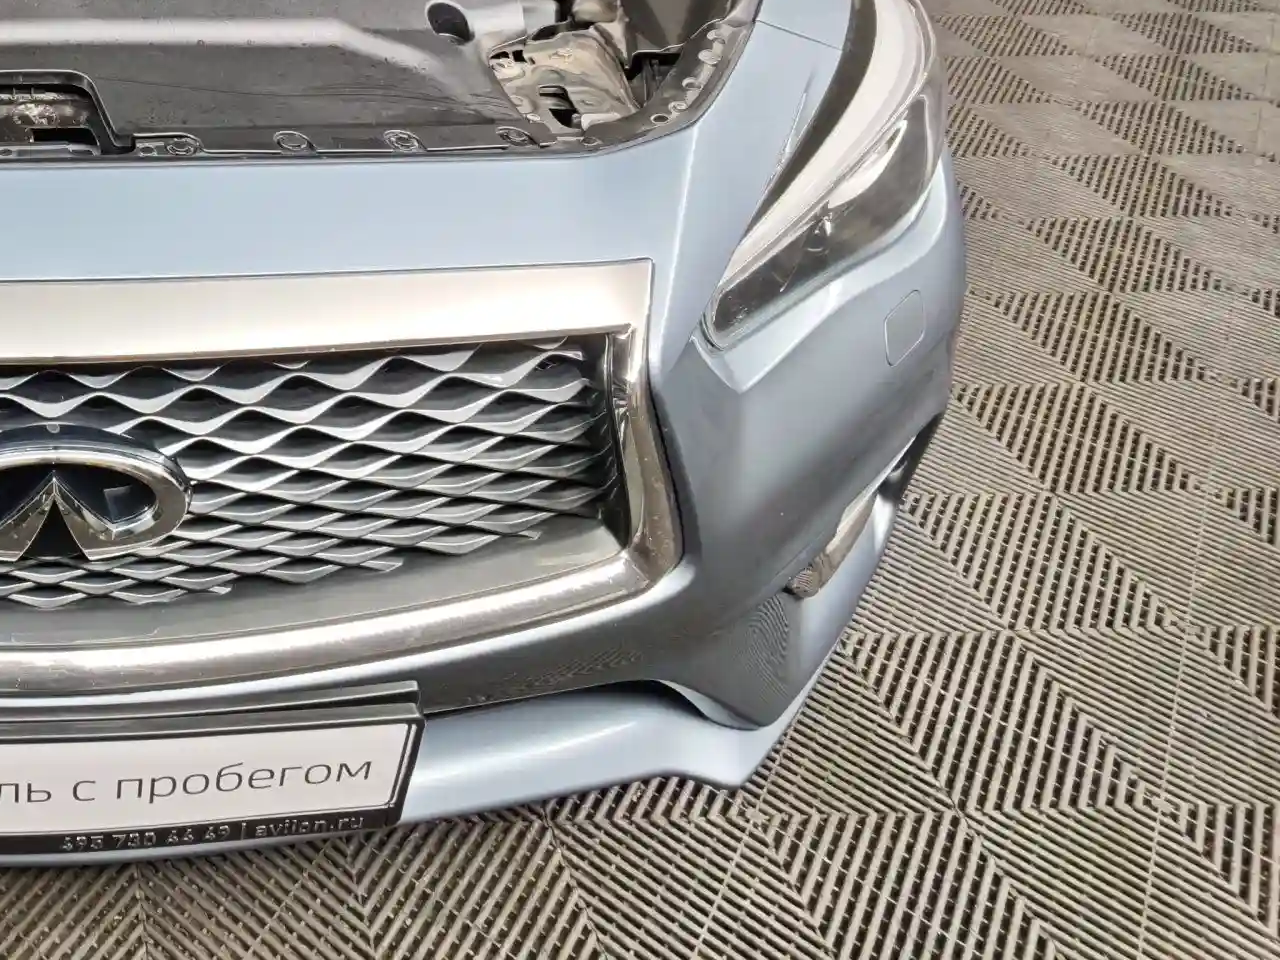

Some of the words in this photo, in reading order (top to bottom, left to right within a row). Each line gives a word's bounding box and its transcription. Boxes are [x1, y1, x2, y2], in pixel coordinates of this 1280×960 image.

[72, 780, 96, 802] с
[116, 760, 372, 804] пробегом
[61, 835, 105, 852] 495
[112, 831, 157, 849] 730
[254, 816, 365, 838] avilon.ru
